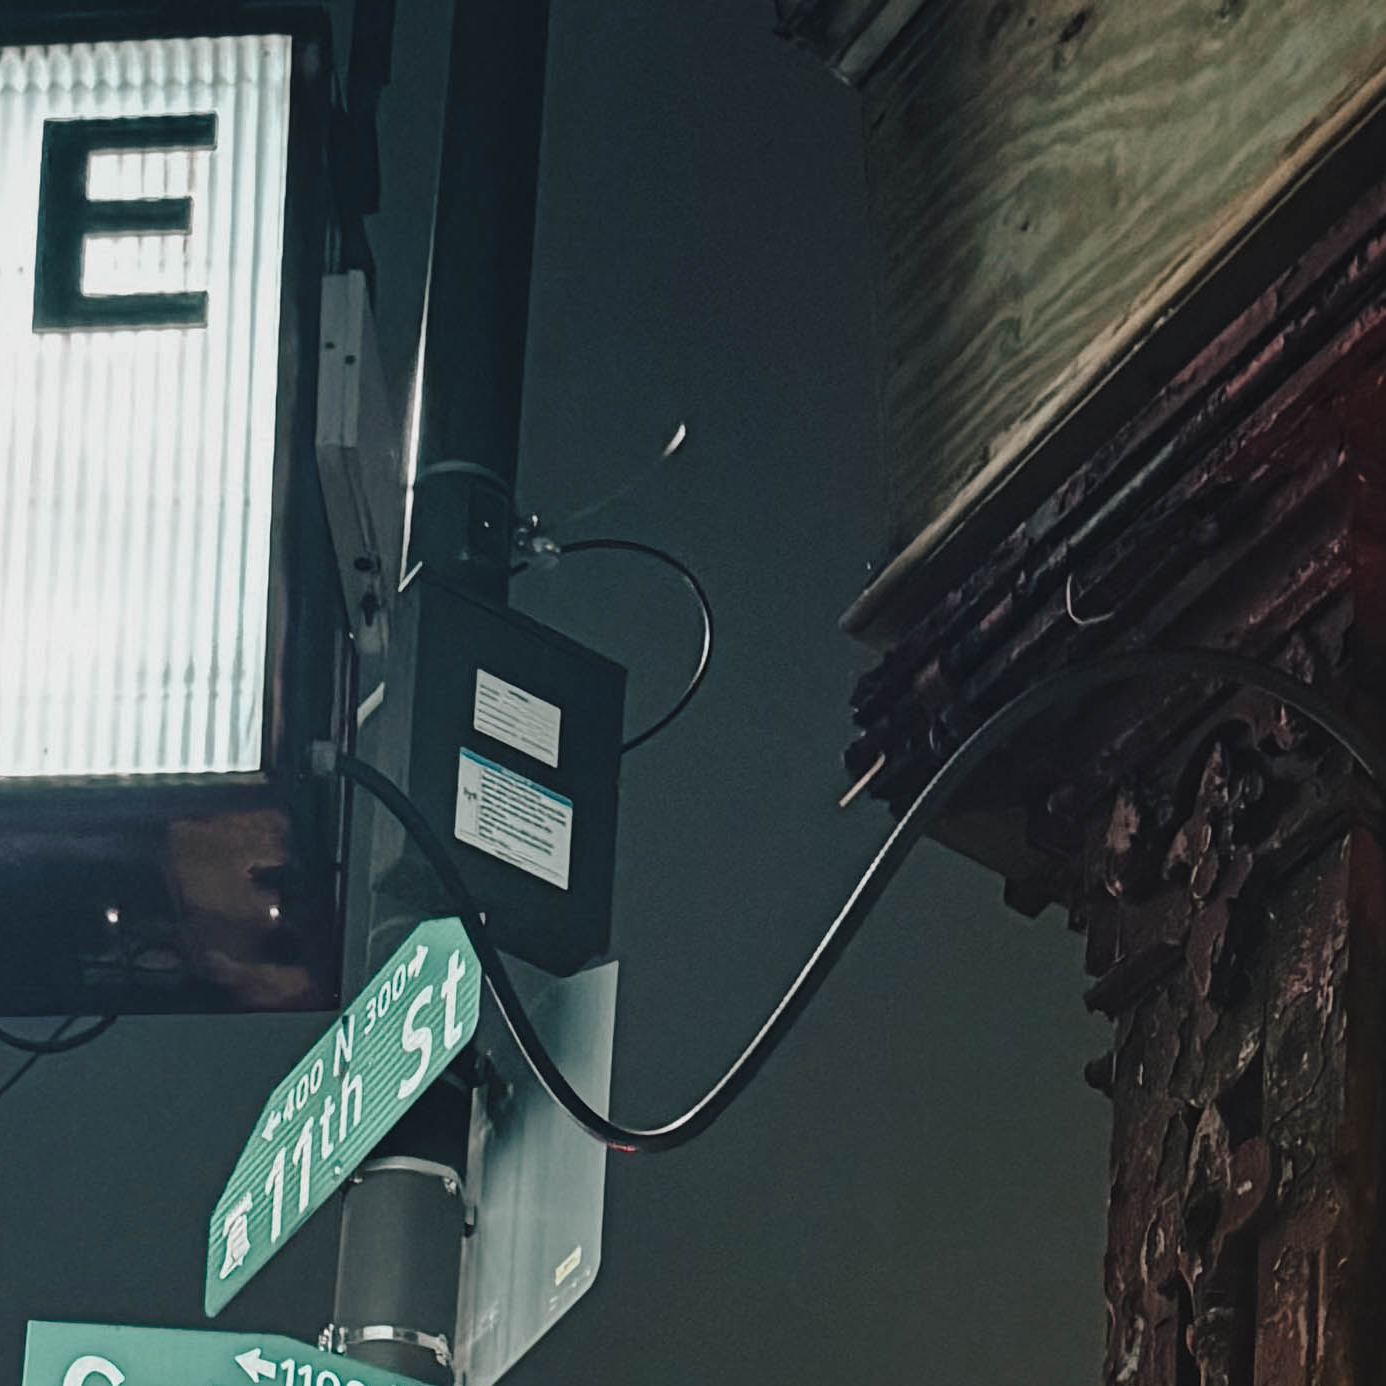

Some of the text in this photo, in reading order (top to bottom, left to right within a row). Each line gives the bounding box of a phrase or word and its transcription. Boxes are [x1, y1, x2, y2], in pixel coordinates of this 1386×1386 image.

[264, 949, 466, 1243] 11th St
[282, 963, 410, 1122] 400 N 300
